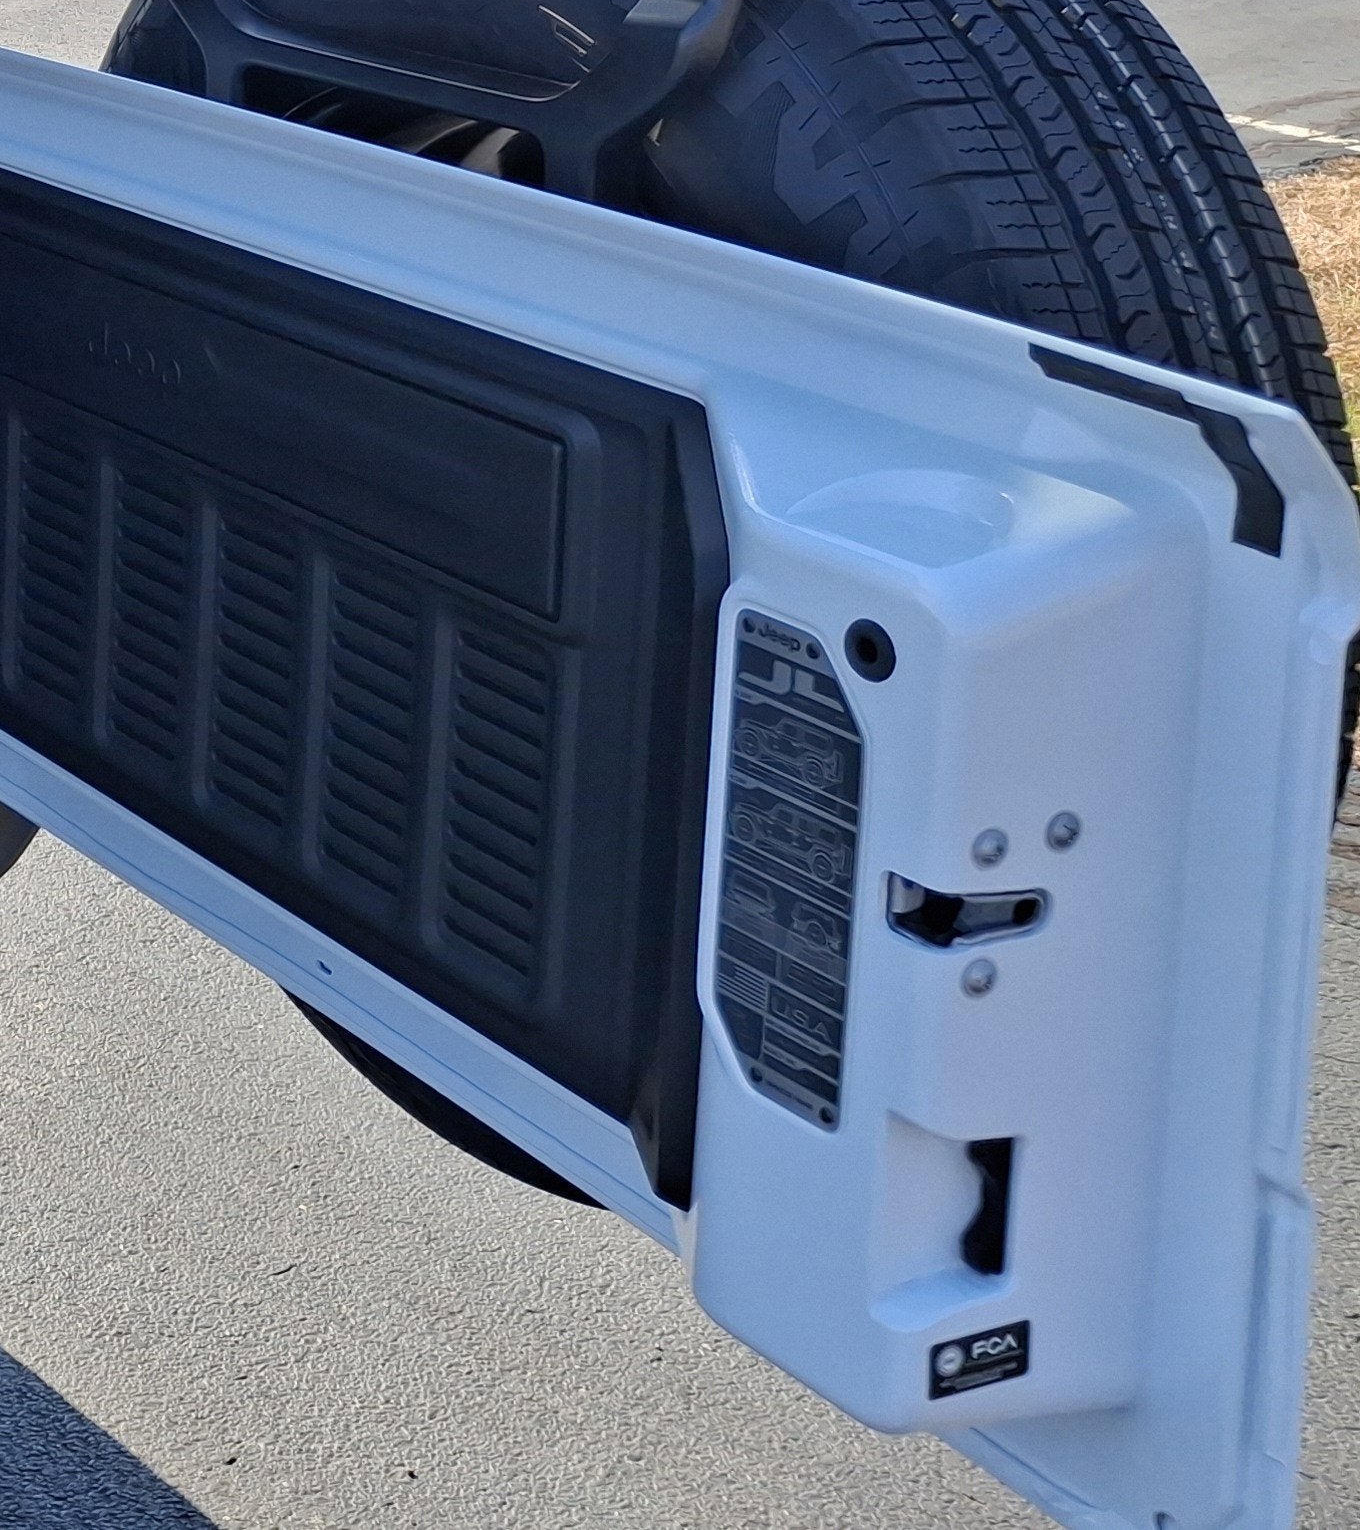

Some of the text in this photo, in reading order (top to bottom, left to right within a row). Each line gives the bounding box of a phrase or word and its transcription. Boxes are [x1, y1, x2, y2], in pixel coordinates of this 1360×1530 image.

[757, 621, 802, 652] Jeep
[737, 658, 845, 714] JL
[771, 1000, 833, 1045] USA
[970, 1332, 1019, 1360] FCA
